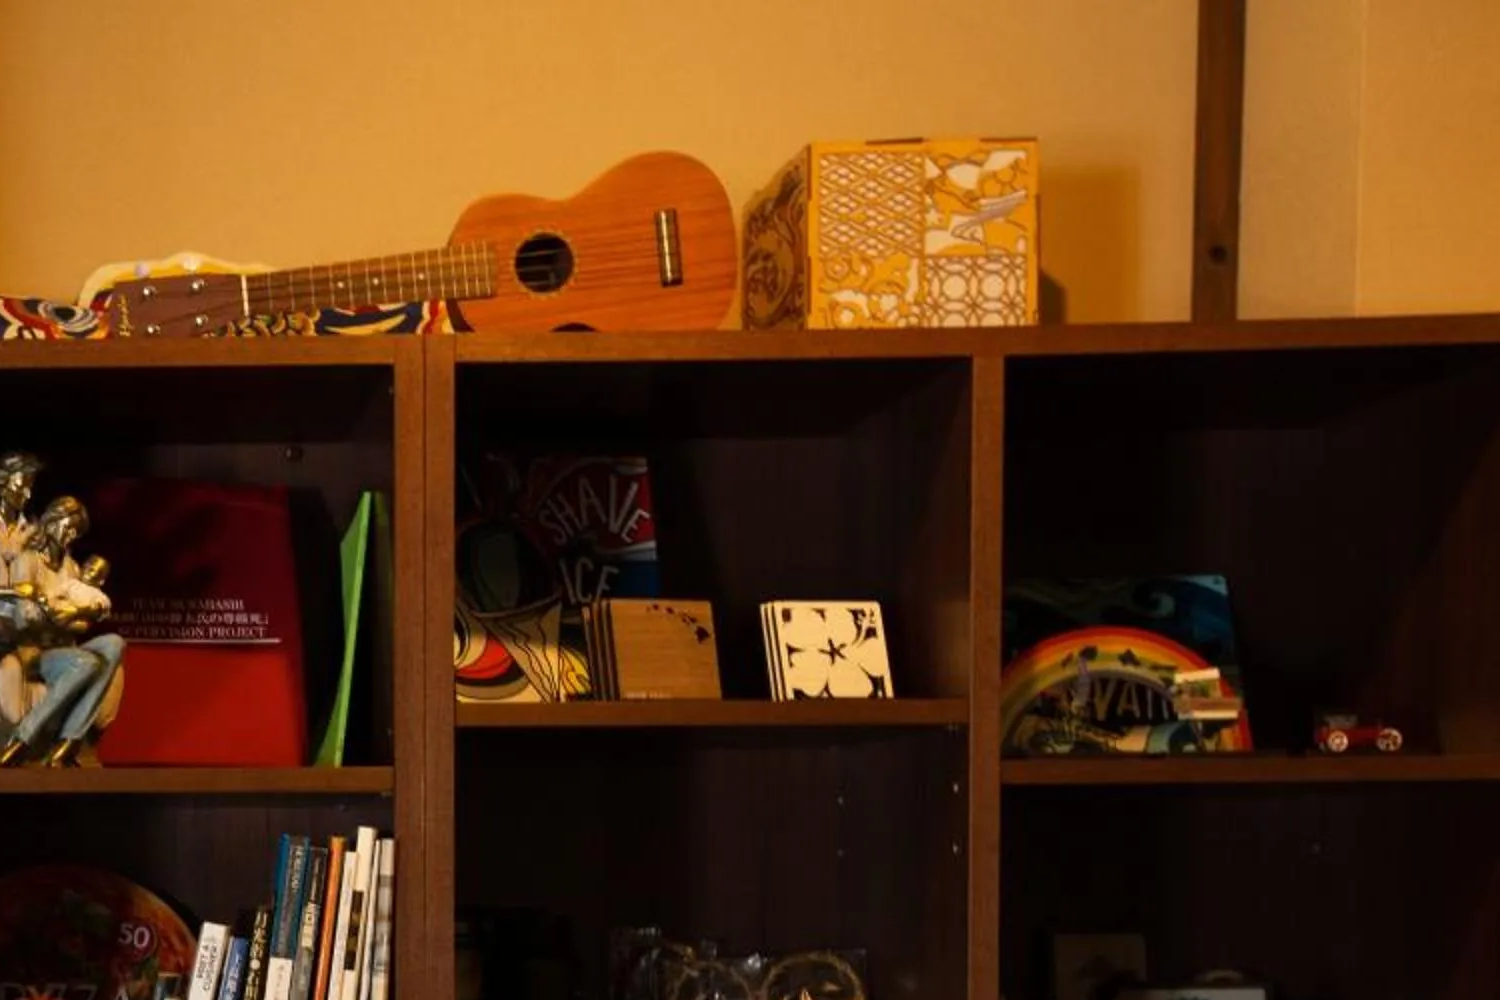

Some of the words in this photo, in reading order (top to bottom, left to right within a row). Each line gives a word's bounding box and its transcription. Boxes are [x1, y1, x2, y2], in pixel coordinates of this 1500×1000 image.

[538, 473, 652, 544] SHAVE
[556, 556, 620, 605] ICE
[117, 922, 152, 948] 50
